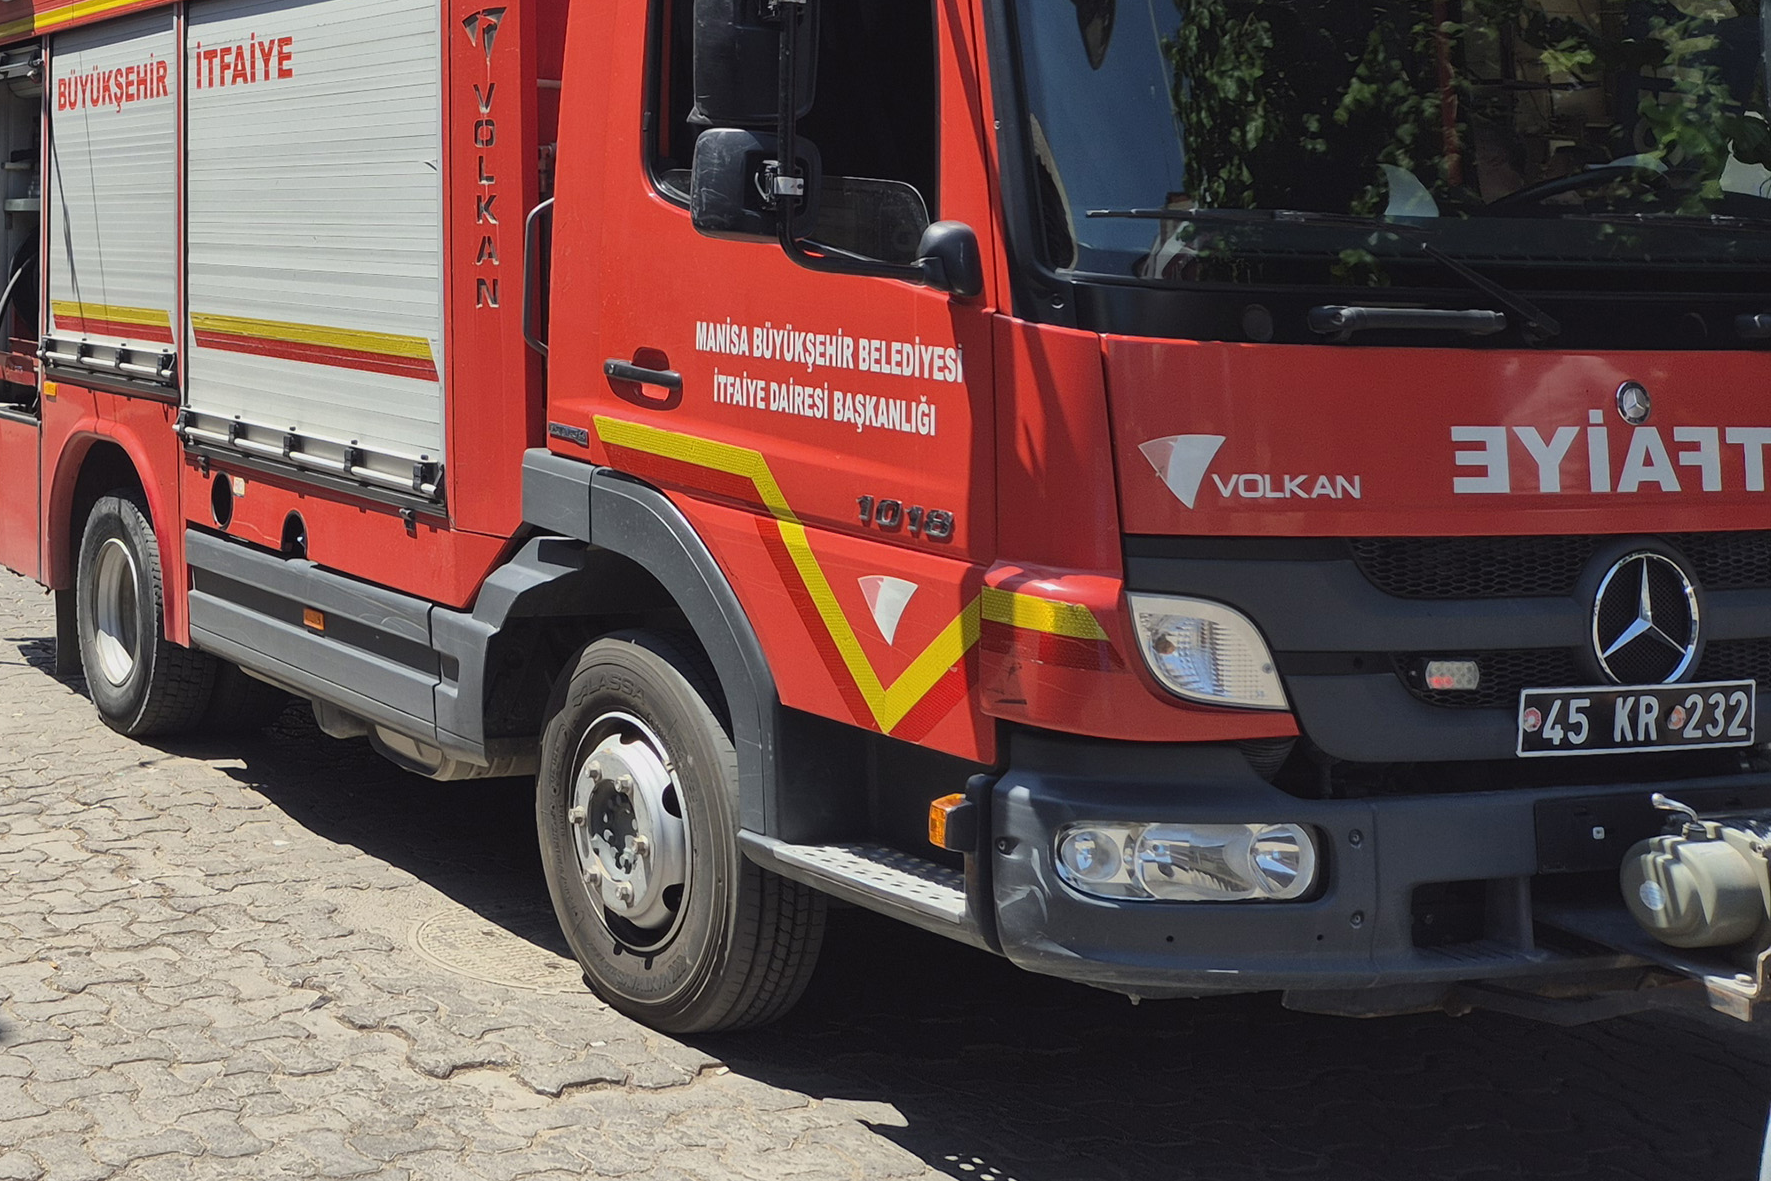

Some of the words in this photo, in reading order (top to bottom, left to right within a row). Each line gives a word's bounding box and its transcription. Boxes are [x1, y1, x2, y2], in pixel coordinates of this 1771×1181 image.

[57, 53, 169, 114] BÜYÜKŞEHİR
[196, 31, 294, 90] İTFAİYE
[472, 82, 500, 309] VOLKAN
[695, 316, 749, 356] MANİSA
[752, 321, 854, 372] BÜYÜKŞEHİR
[858, 336, 963, 383] BELEDİYESİ
[713, 367, 766, 410] İTFAİYE
[769, 376, 829, 420] DAİRESİ
[833, 390, 936, 437] BAŞKANLIĞI
[855, 494, 955, 538] 1018
[1211, 473, 1362, 499] VOLKAN
[1542, 698, 1591, 746] 45
[1613, 695, 1660, 743] KR
[1682, 690, 1749, 739] 232
